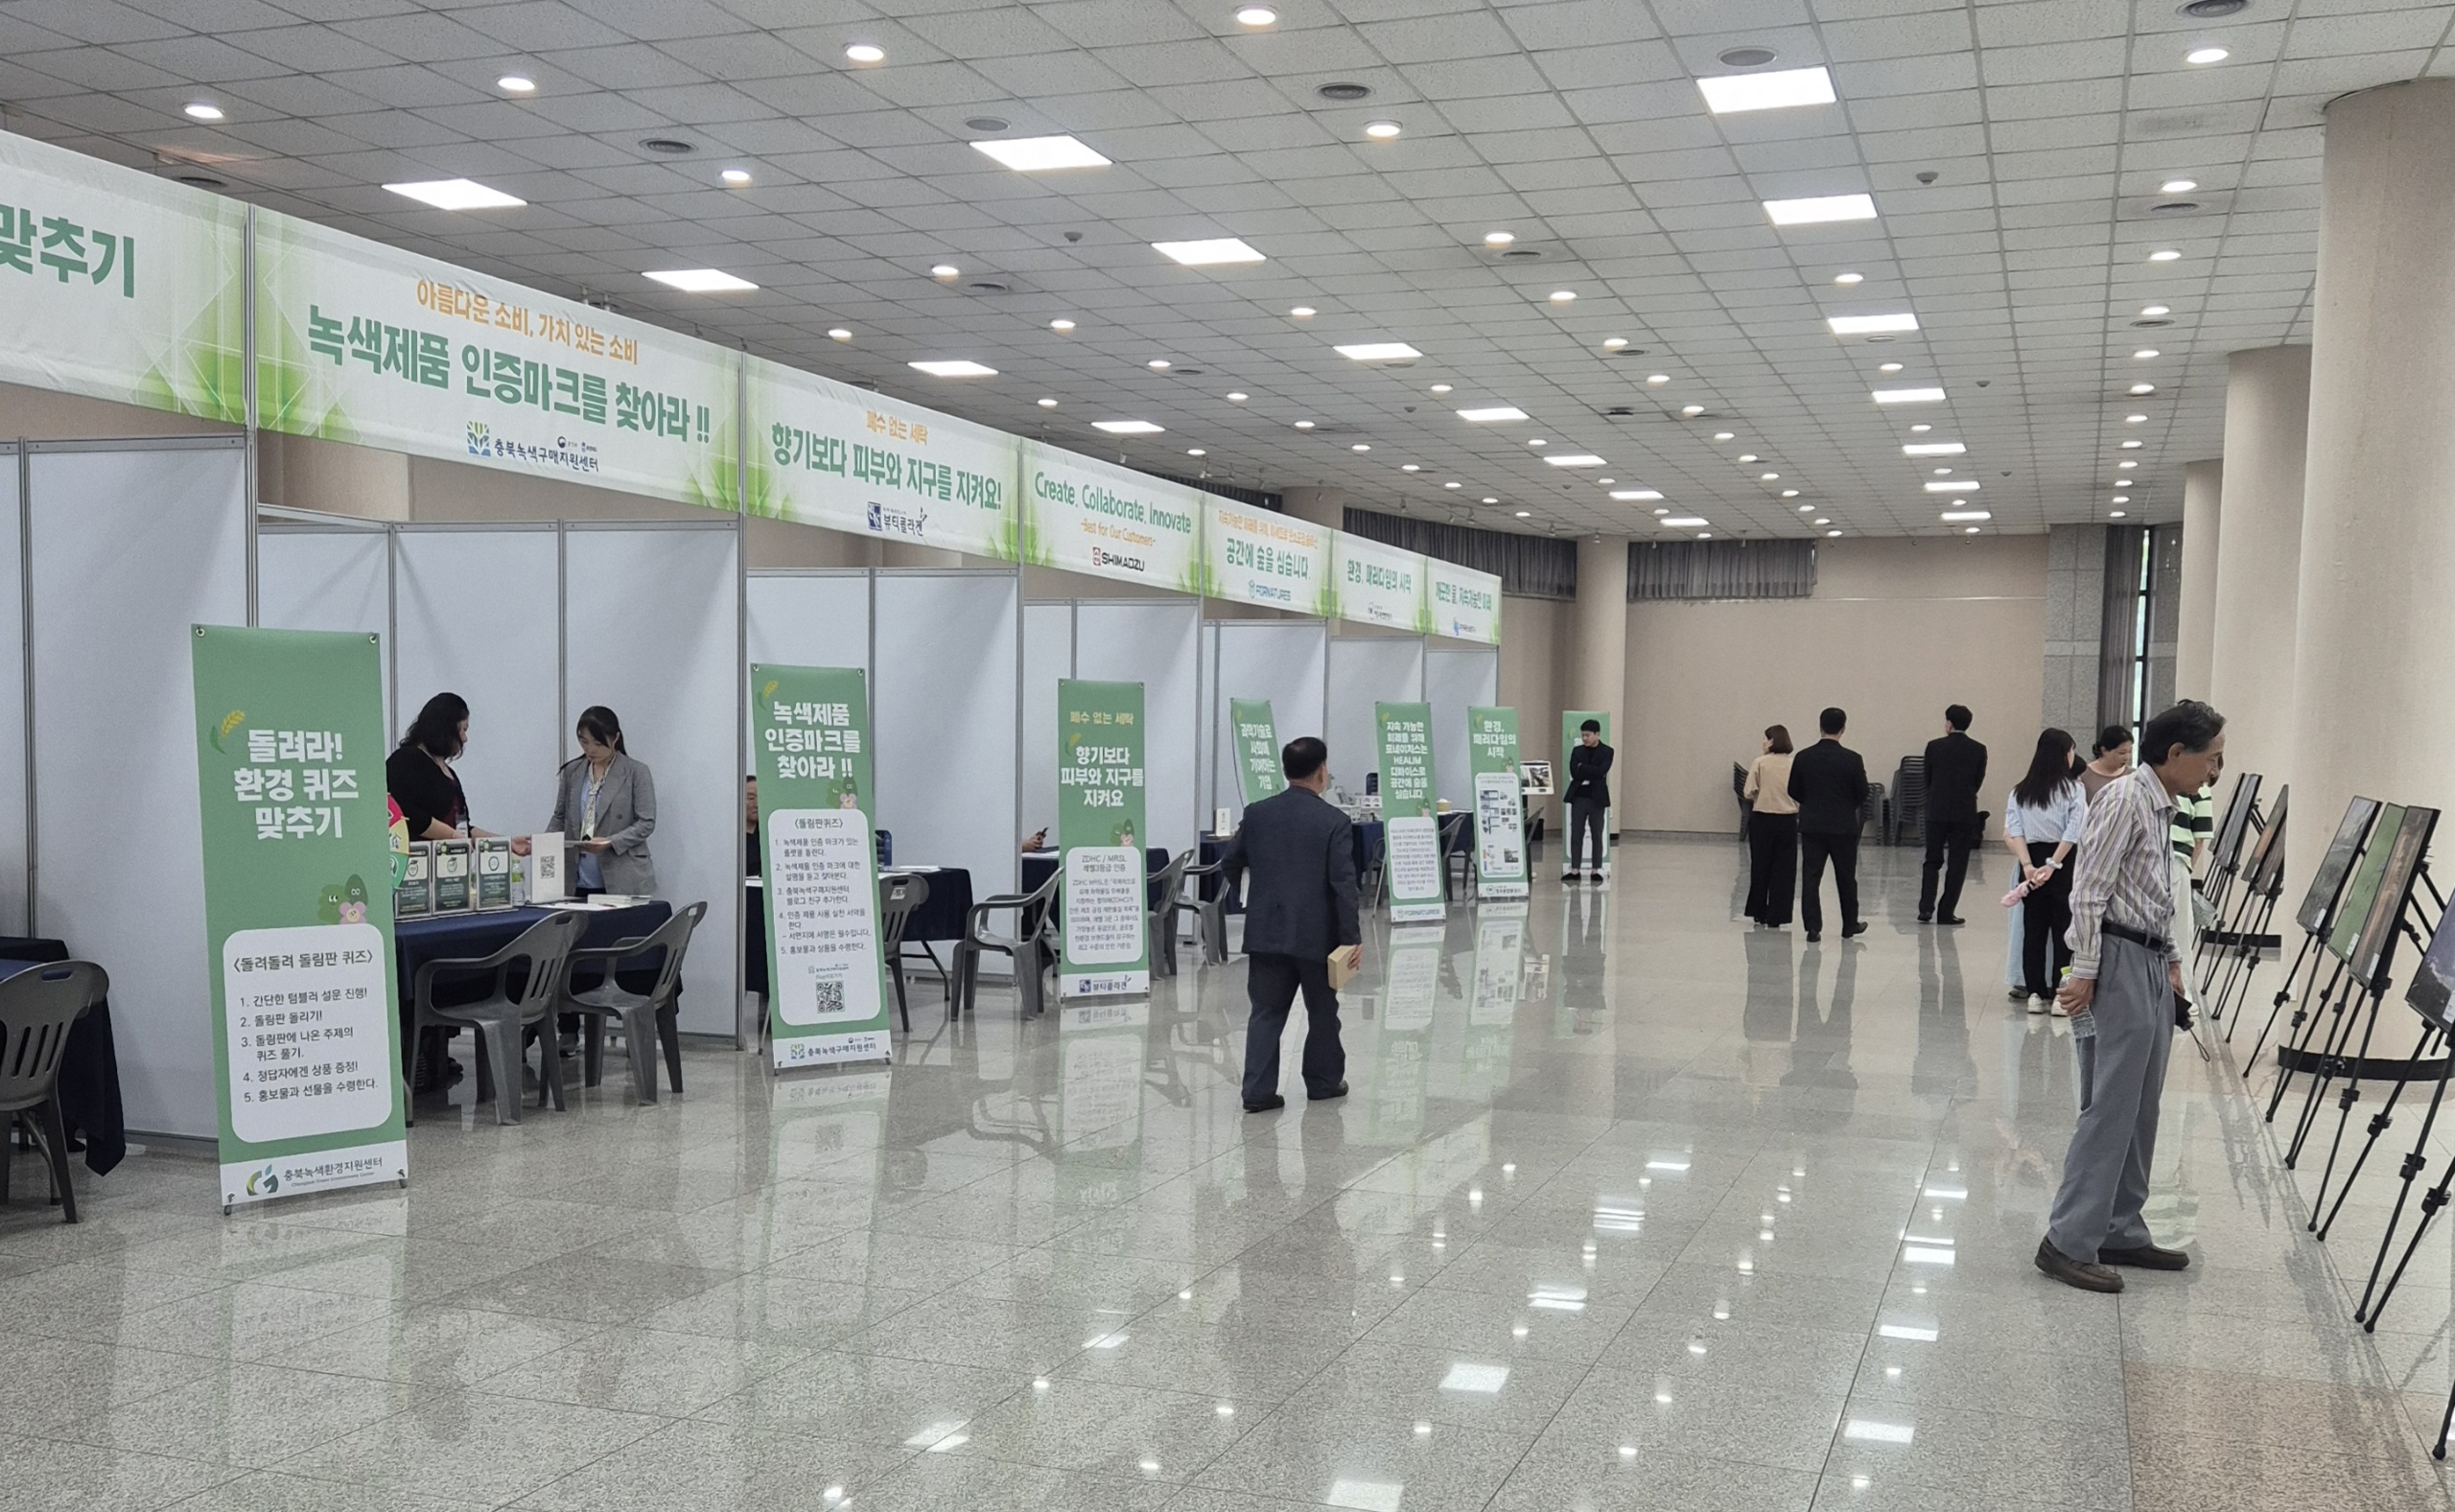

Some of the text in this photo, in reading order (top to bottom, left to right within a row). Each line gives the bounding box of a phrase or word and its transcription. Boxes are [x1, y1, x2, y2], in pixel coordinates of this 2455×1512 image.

[0, 203, 134, 298] 맞추기
[417, 279, 638, 365] 아름다운 소비, 가치 있는 소비
[308, 304, 450, 389] 녹색제품
[461, 344, 607, 425] 인증마크를
[616, 382, 690, 443] 찾아라
[867, 410, 886, 433] 폐수
[888, 416, 907, 440] 없는
[495, 438, 599, 472] 충북녹색구매지원센터
[772, 422, 1002, 510] 향기보다 피부와 지구를 지켜요!
[1035, 472, 1078, 507] Create.
[1082, 484, 1146, 524] Collaborate.
[1150, 501, 1191, 534] Innovate
[1102, 552, 1145, 571] SHIMADZU
[1227, 537, 1254, 569] 공간에
[1257, 546, 1274, 572] 숲을
[1399, 571, 1412, 594] 시작
[773, 701, 851, 726] 녹색제품
[1092, 711, 1112, 725] 없는
[1386, 721, 1424, 732] 지속 가능한
[247, 729, 343, 762] 돌려라!
[764, 728, 861, 753] 인증마크를
[1473, 733, 1516, 745] 패러다임의
[1076, 746, 1130, 765] 향기보다
[1487, 746, 1505, 757] 시작
[778, 755, 835, 779] 찾아라
[1061, 767, 1144, 786] 피부와 지구를
[234, 768, 359, 802] 환경 퀴즈
[1257, 775, 1273, 790] 기업
[1391, 778, 1428, 788] 공간에 숲을
[1084, 789, 1124, 807] 지켜요
[255, 806, 342, 840] 맞추기
[1082, 854, 1101, 863] ZDHC
[298, 952, 338, 968] 돌림판
[240, 997, 250, 1007] 1.
[253, 994, 284, 1007] 간단한
[288, 991, 318, 1005] 텀블러
[240, 1017, 251, 1027] 2.
[254, 1013, 285, 1027] 돌림판
[241, 1027, 354, 1047] 3. 돌림판에 나온 주제의
[257, 1050, 277, 1061] 퀴즈
[243, 1073, 253, 1082] 4.
[312, 1063, 332, 1077] 상품
[244, 1078, 378, 1103] 5. 홍보물과 선물을 수령한다.
[283, 1157, 383, 1182] 충북녹색환경지원센터
